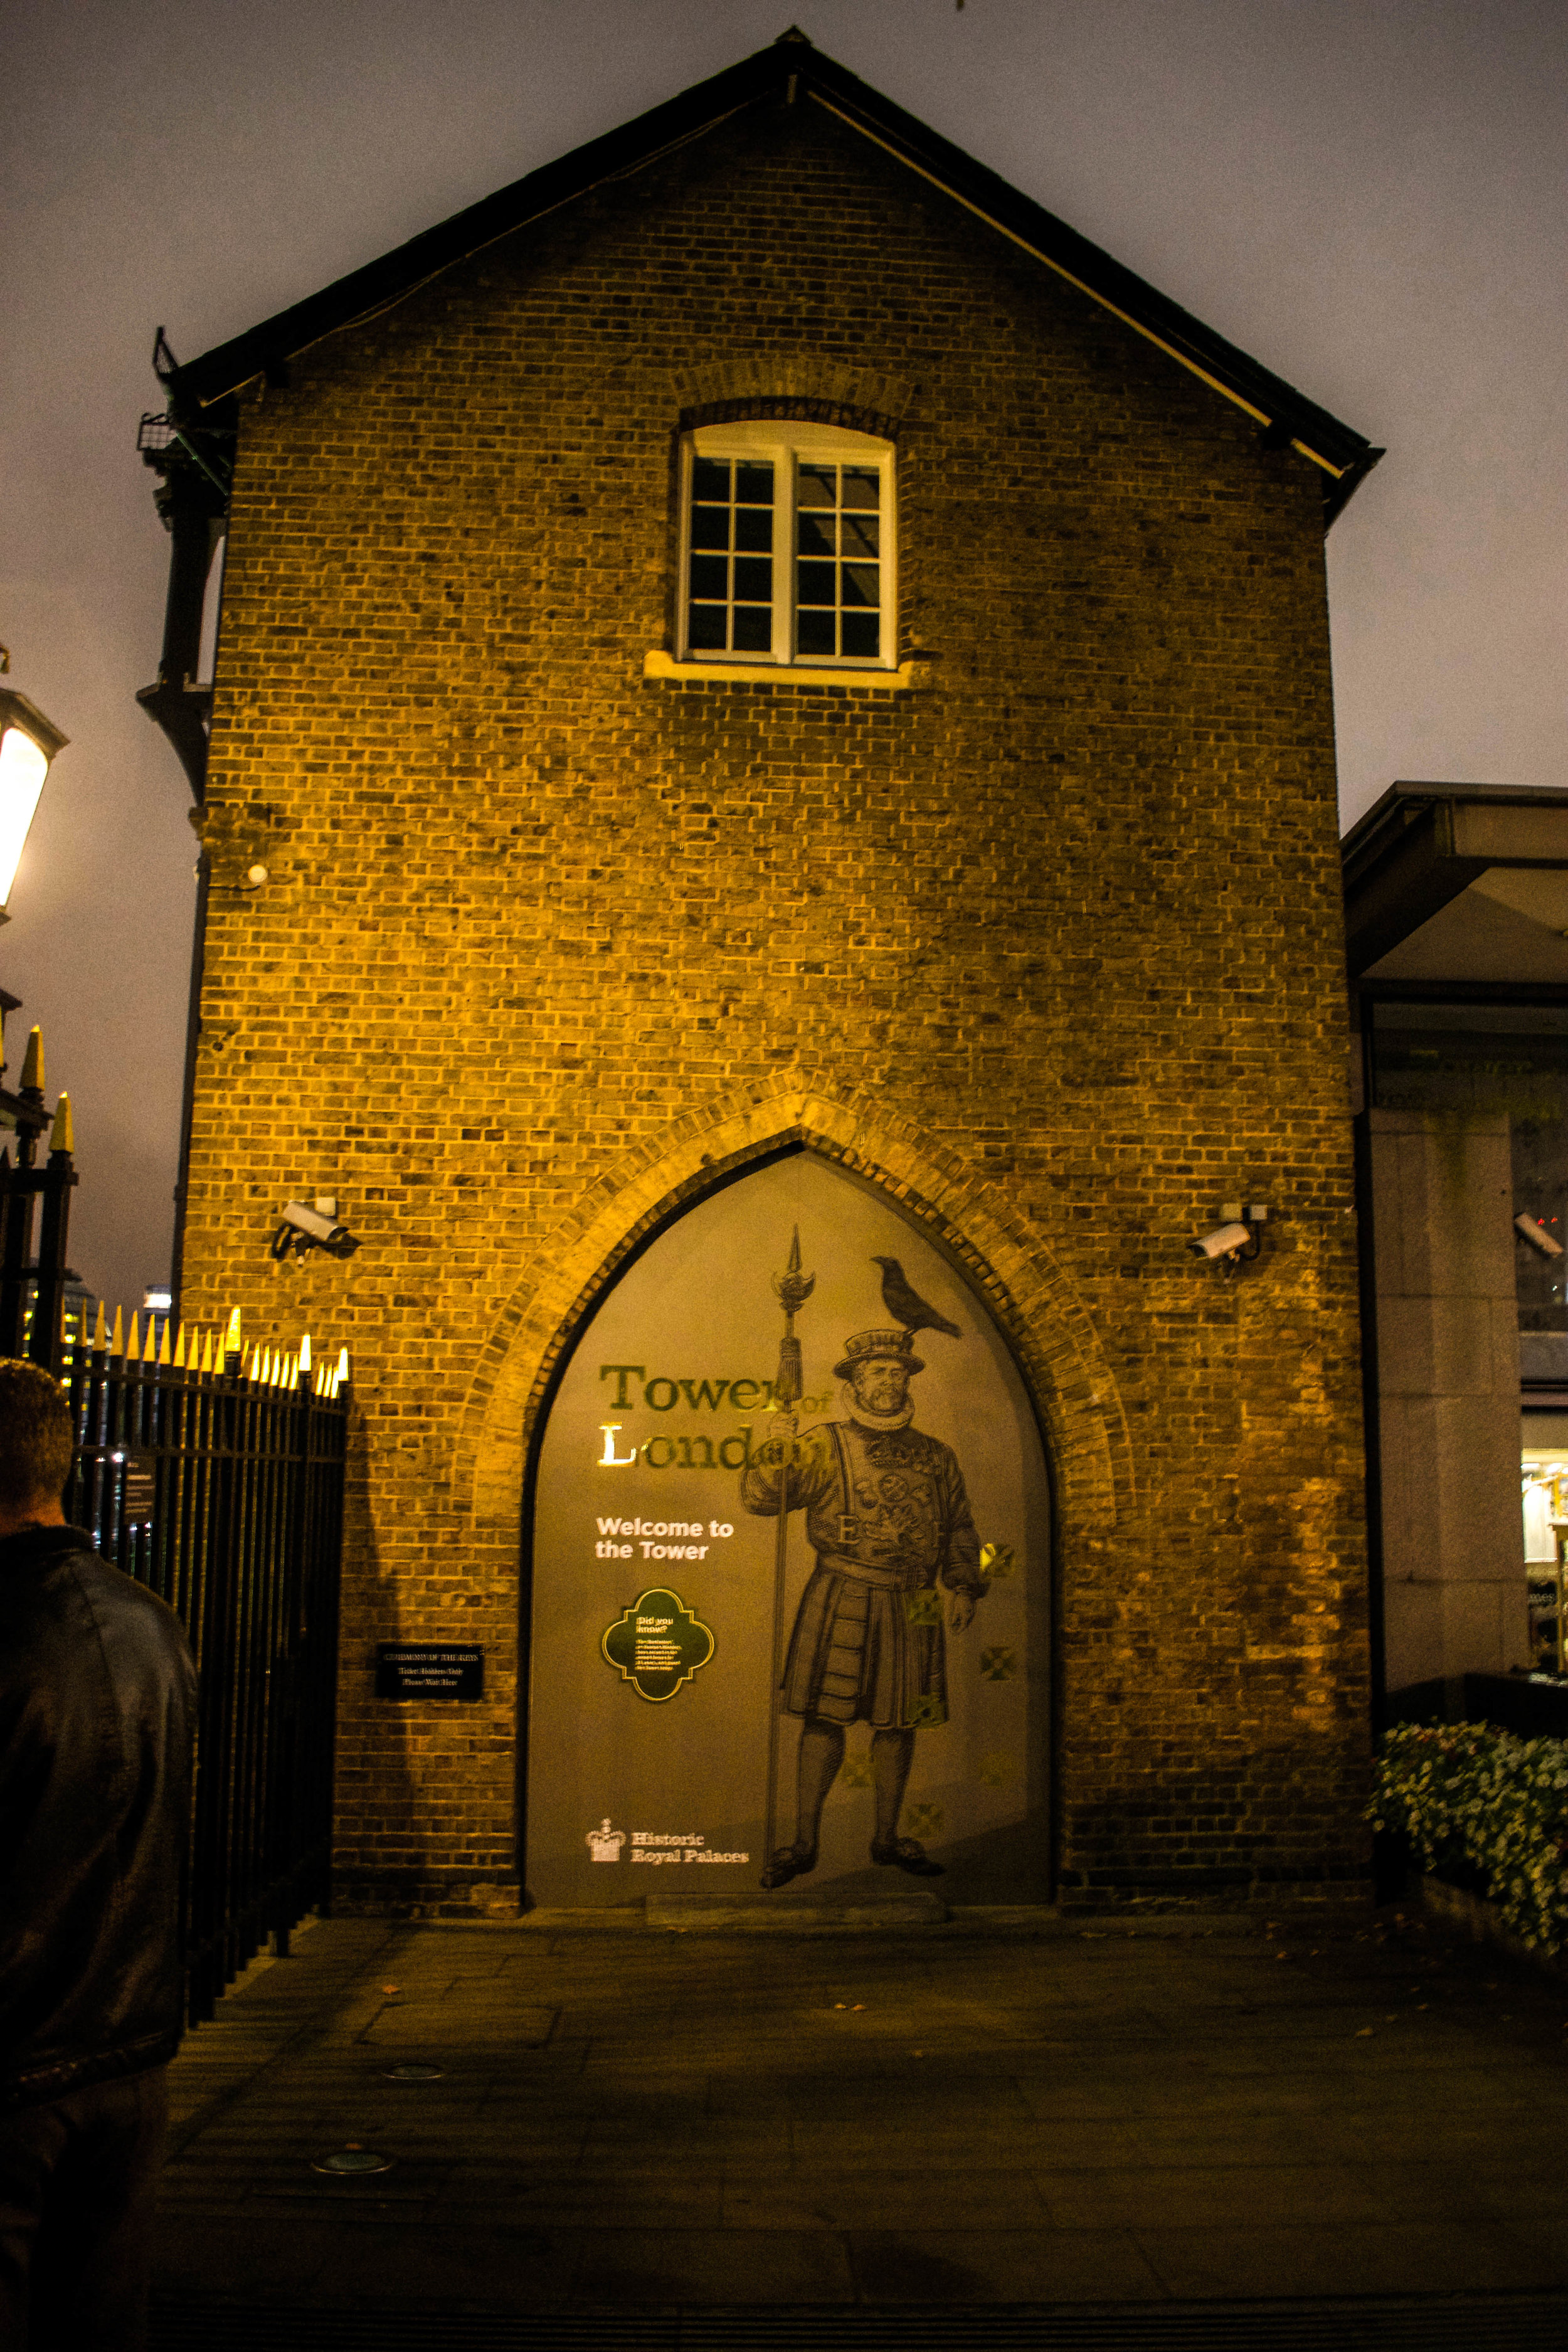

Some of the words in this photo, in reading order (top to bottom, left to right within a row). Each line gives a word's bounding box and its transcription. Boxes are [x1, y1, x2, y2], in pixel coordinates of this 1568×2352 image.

[600, 1365, 785, 1412] Tower
[597, 1421, 830, 1470] London
[596, 1517, 704, 1537] Welcome
[709, 1520, 734, 1538] to
[595, 1540, 633, 1559] the
[638, 1540, 709, 1560] Tower
[635, 1624, 668, 1633] know?
[636, 1616, 654, 1625] Did
[655, 1618, 674, 1626] you
[631, 1831, 704, 1846] Historic
[630, 1849, 681, 1866] Royal
[682, 1849, 750, 1863] Palaces
